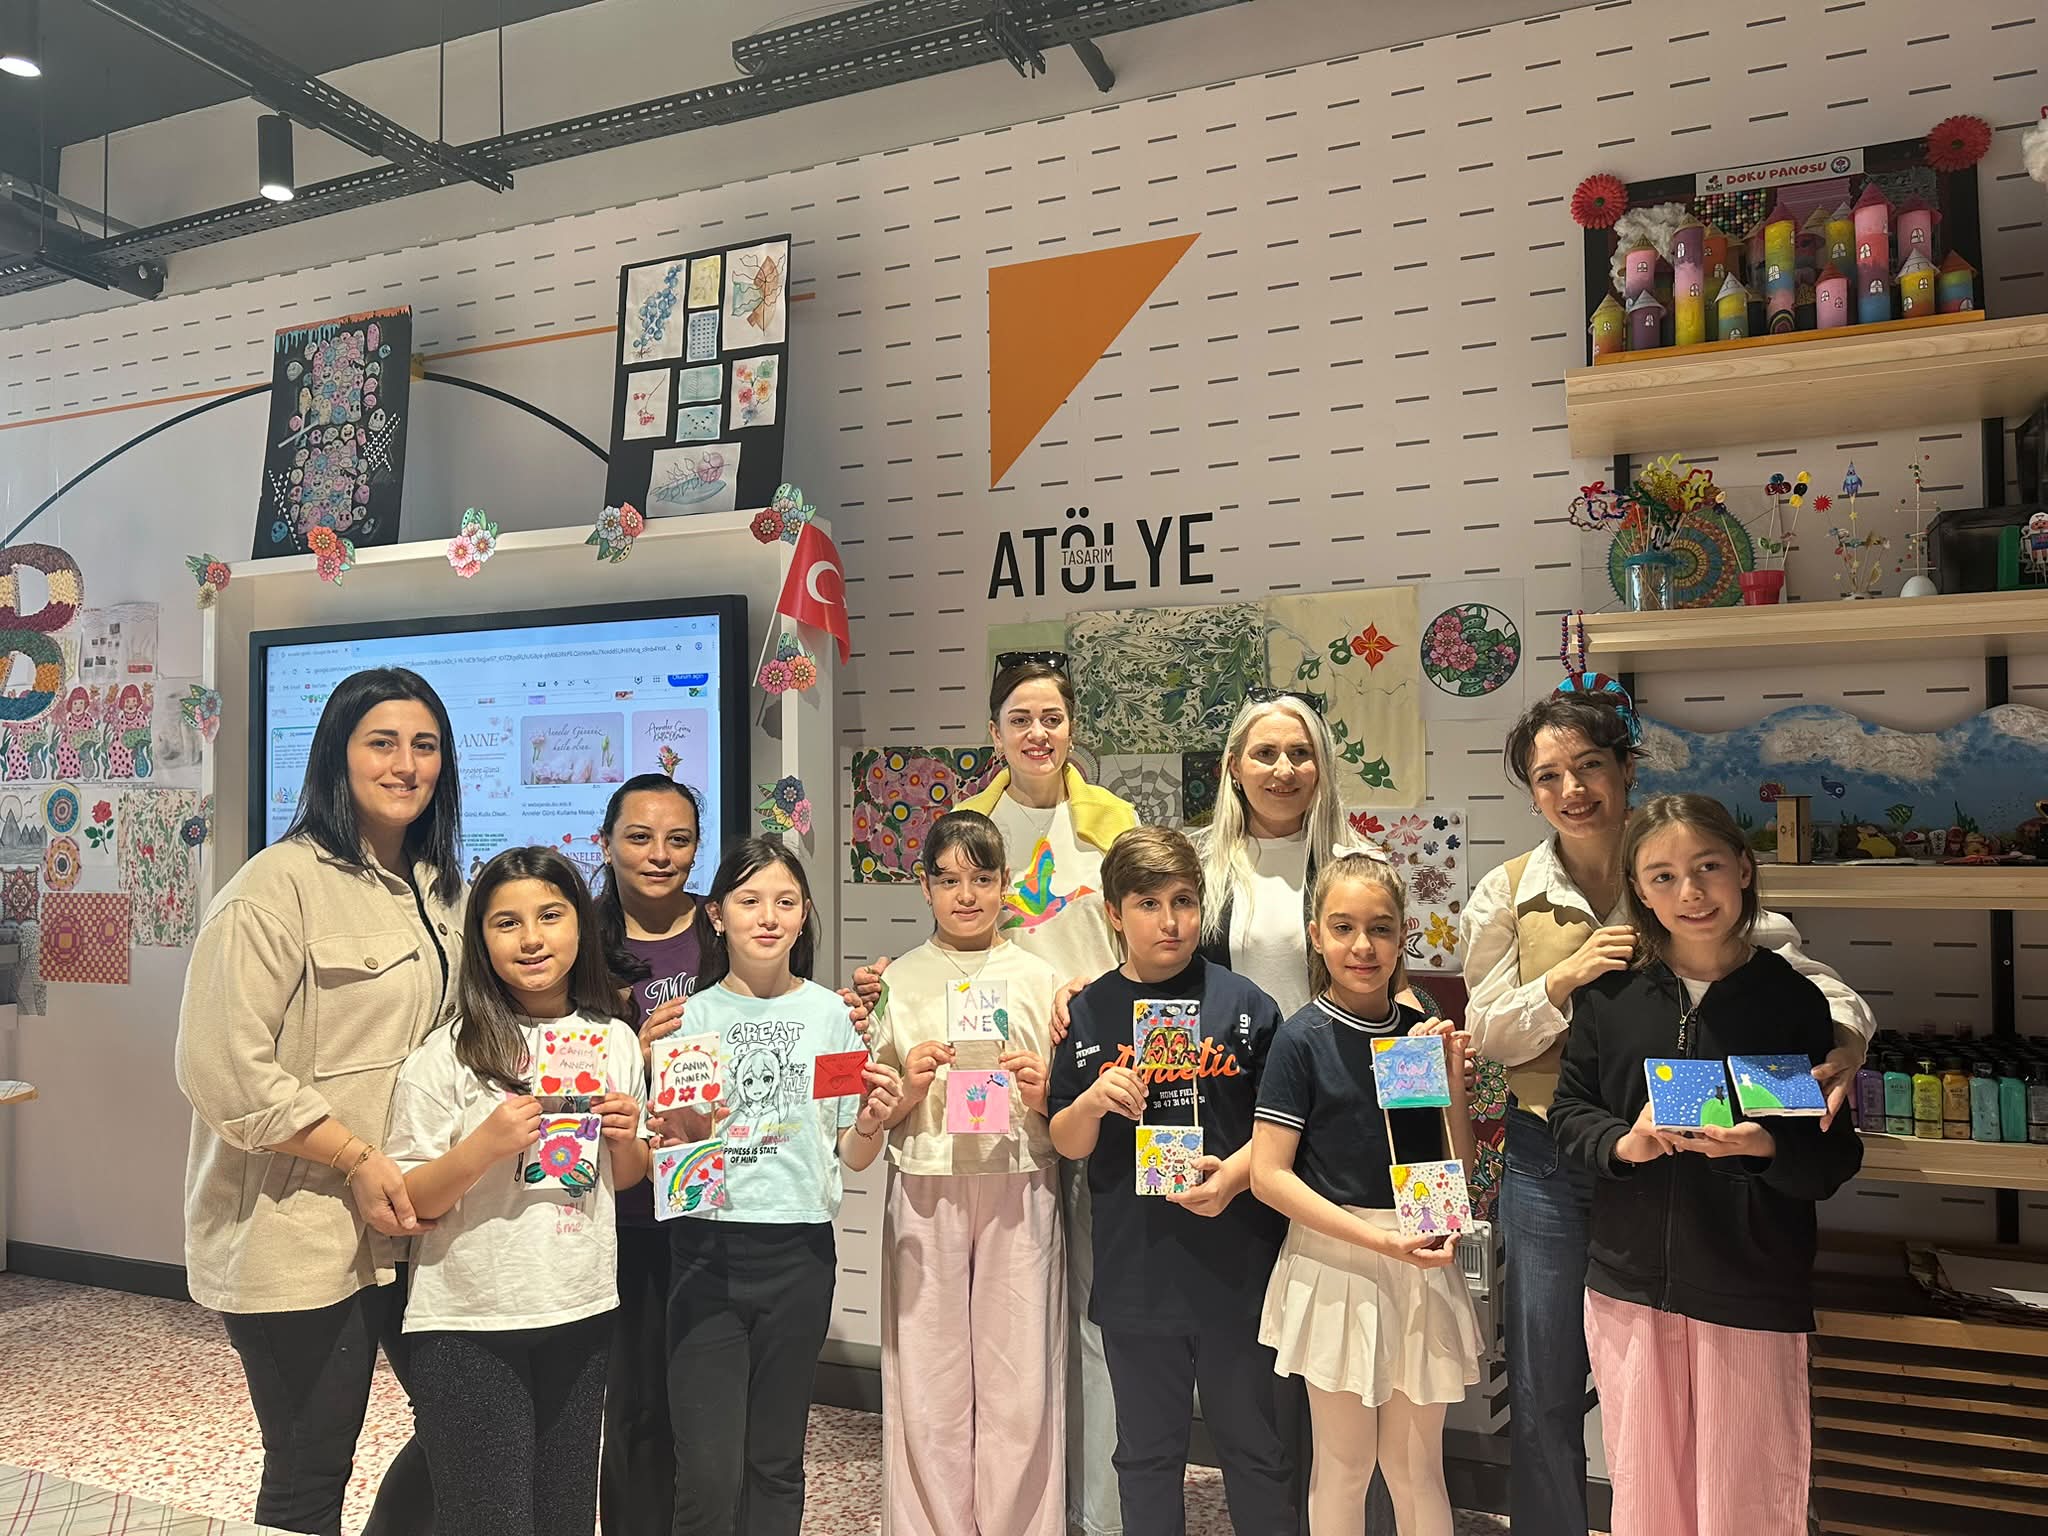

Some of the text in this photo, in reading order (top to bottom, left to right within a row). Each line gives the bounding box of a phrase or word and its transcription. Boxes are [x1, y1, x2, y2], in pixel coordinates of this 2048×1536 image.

[1726, 161, 1828, 185] DOKU PANOSU
[987, 506, 1214, 600] ATÖLYE
[1061, 547, 1114, 567] TASARIM
[458, 732, 500, 748] ANNE
[726, 1020, 806, 1045] GREAT
[673, 1061, 710, 1075] CANIM
[674, 1072, 711, 1087] ANNEM
[1159, 1087, 1199, 1100] HOME FIEL
[751, 1147, 758, 1155] IS
[759, 1146, 778, 1155] STATE
[730, 1155, 758, 1164] OF MIND
